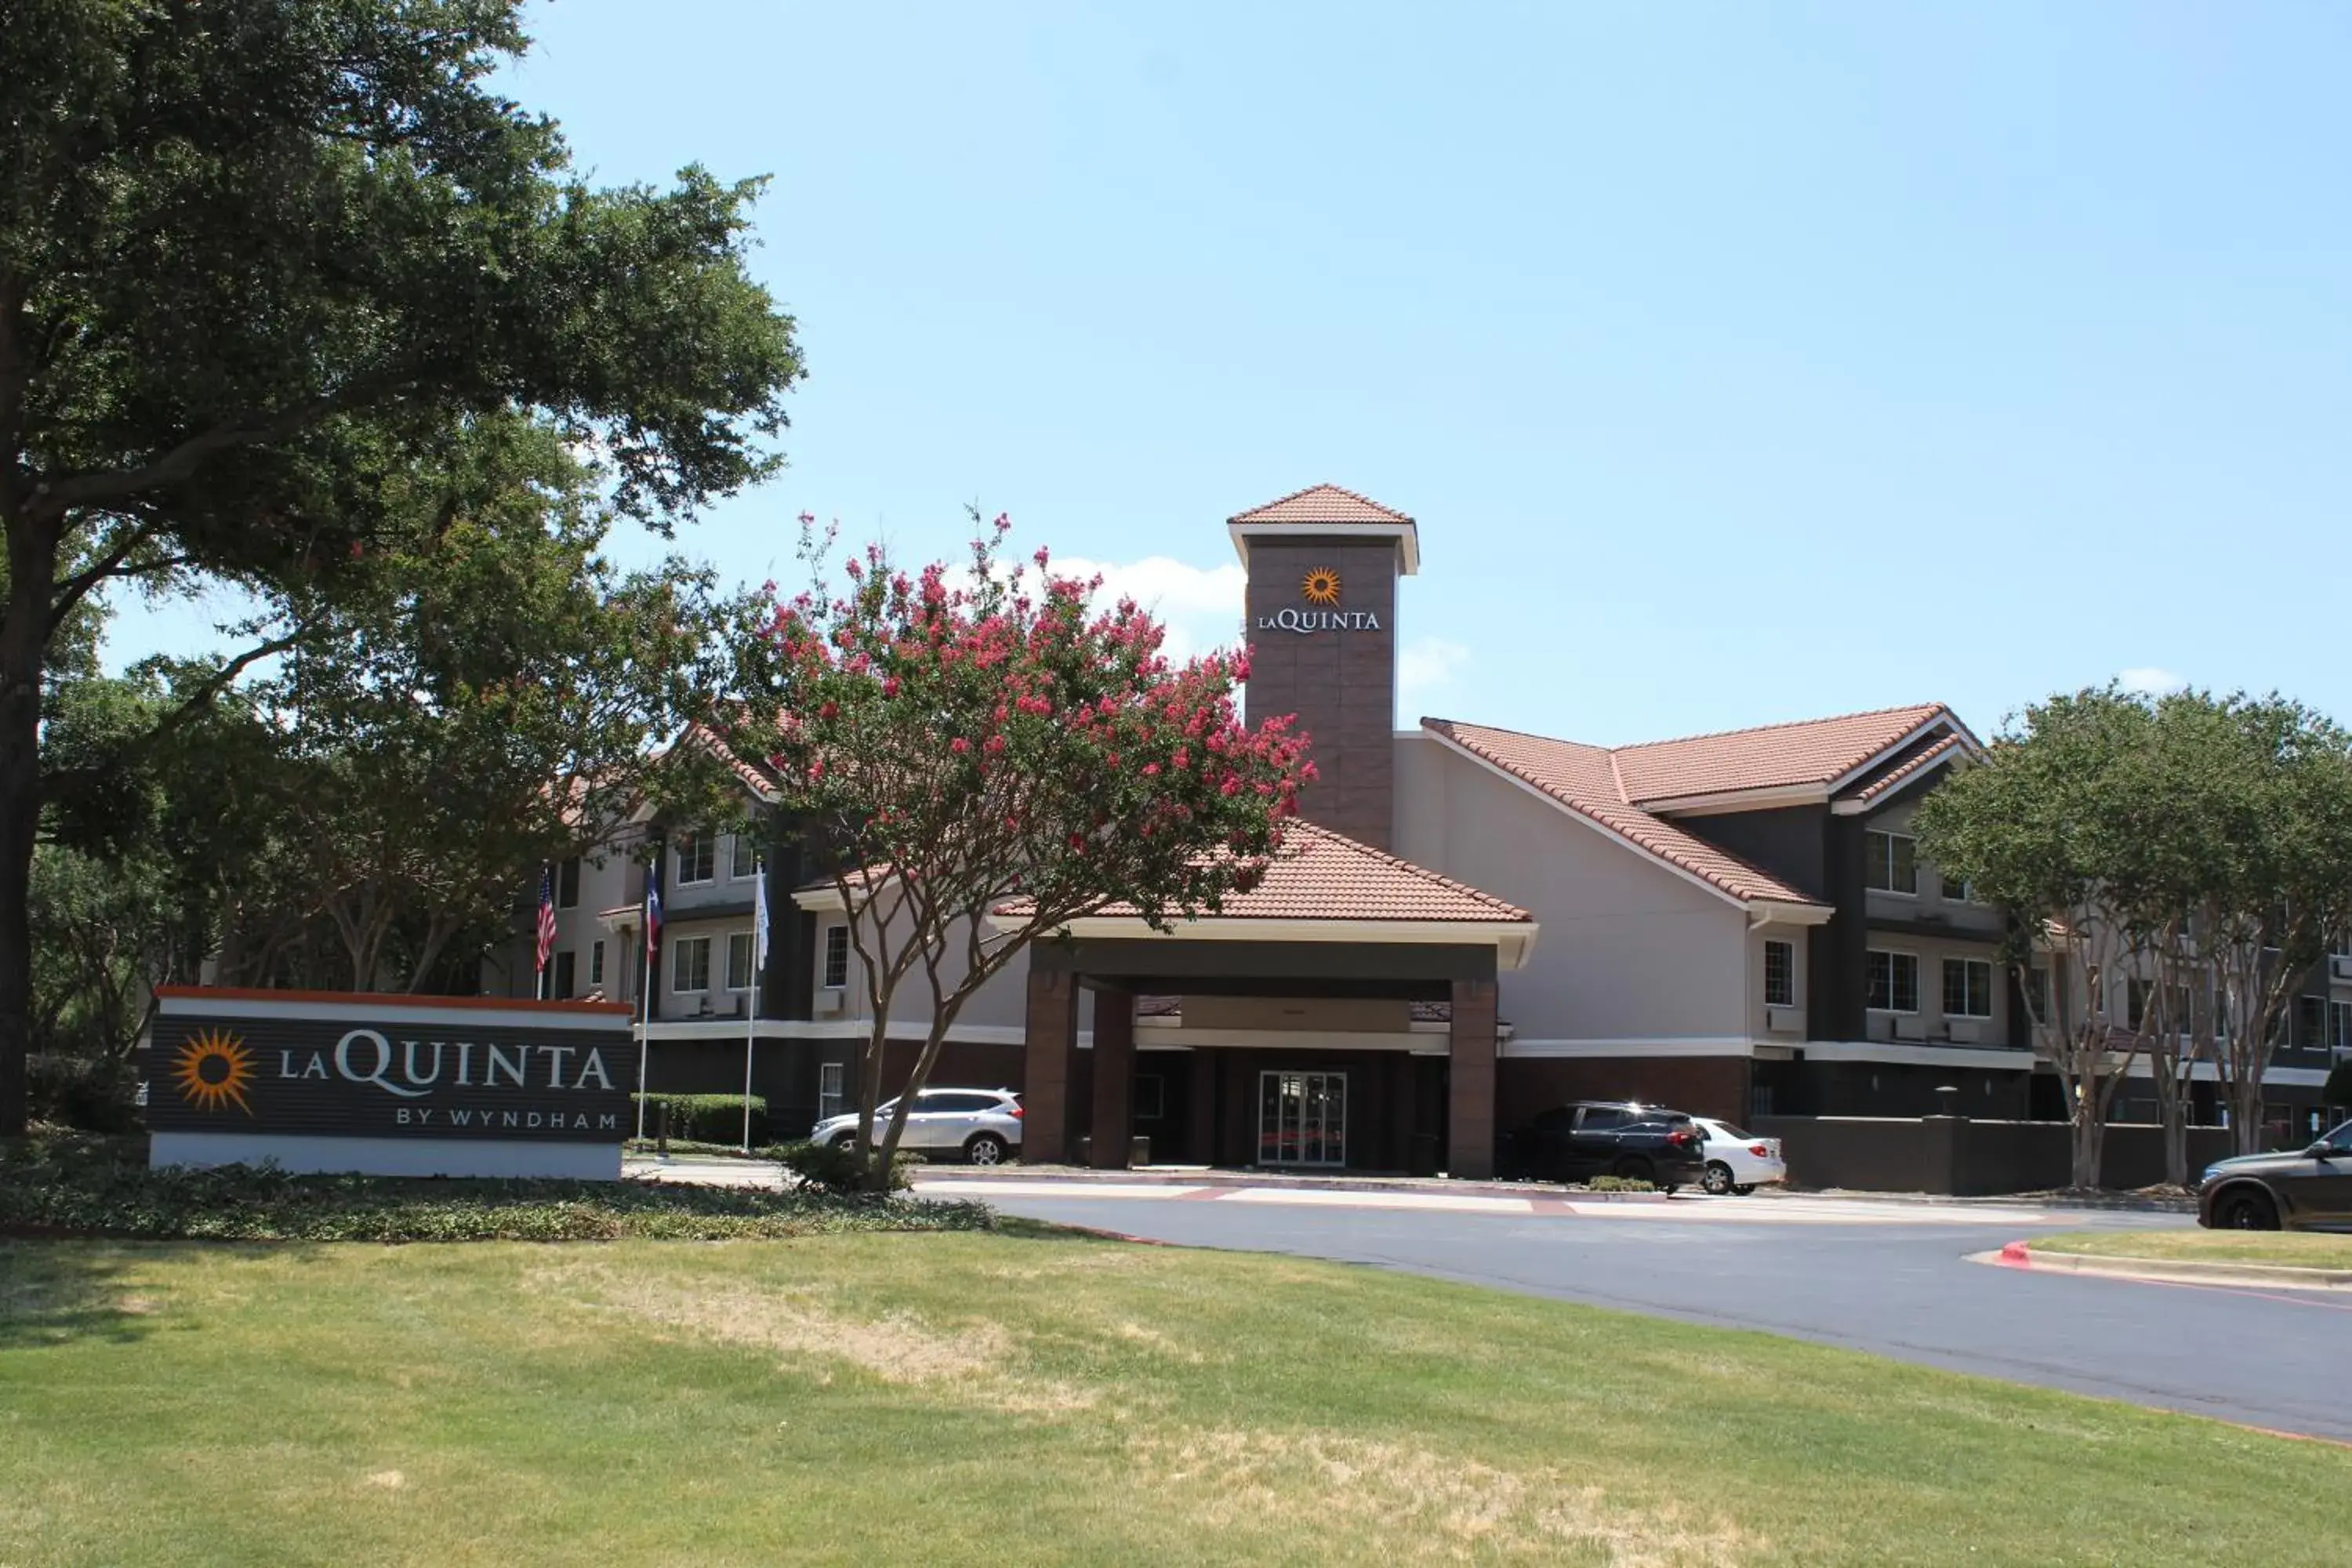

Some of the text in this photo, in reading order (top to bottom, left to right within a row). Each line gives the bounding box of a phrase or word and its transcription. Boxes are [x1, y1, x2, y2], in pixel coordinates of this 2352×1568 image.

[1277, 608, 1381, 633] QUINTA
[279, 1028, 615, 1097] LA QUINTA
[396, 1108, 616, 1130] BY WYNDHAM
